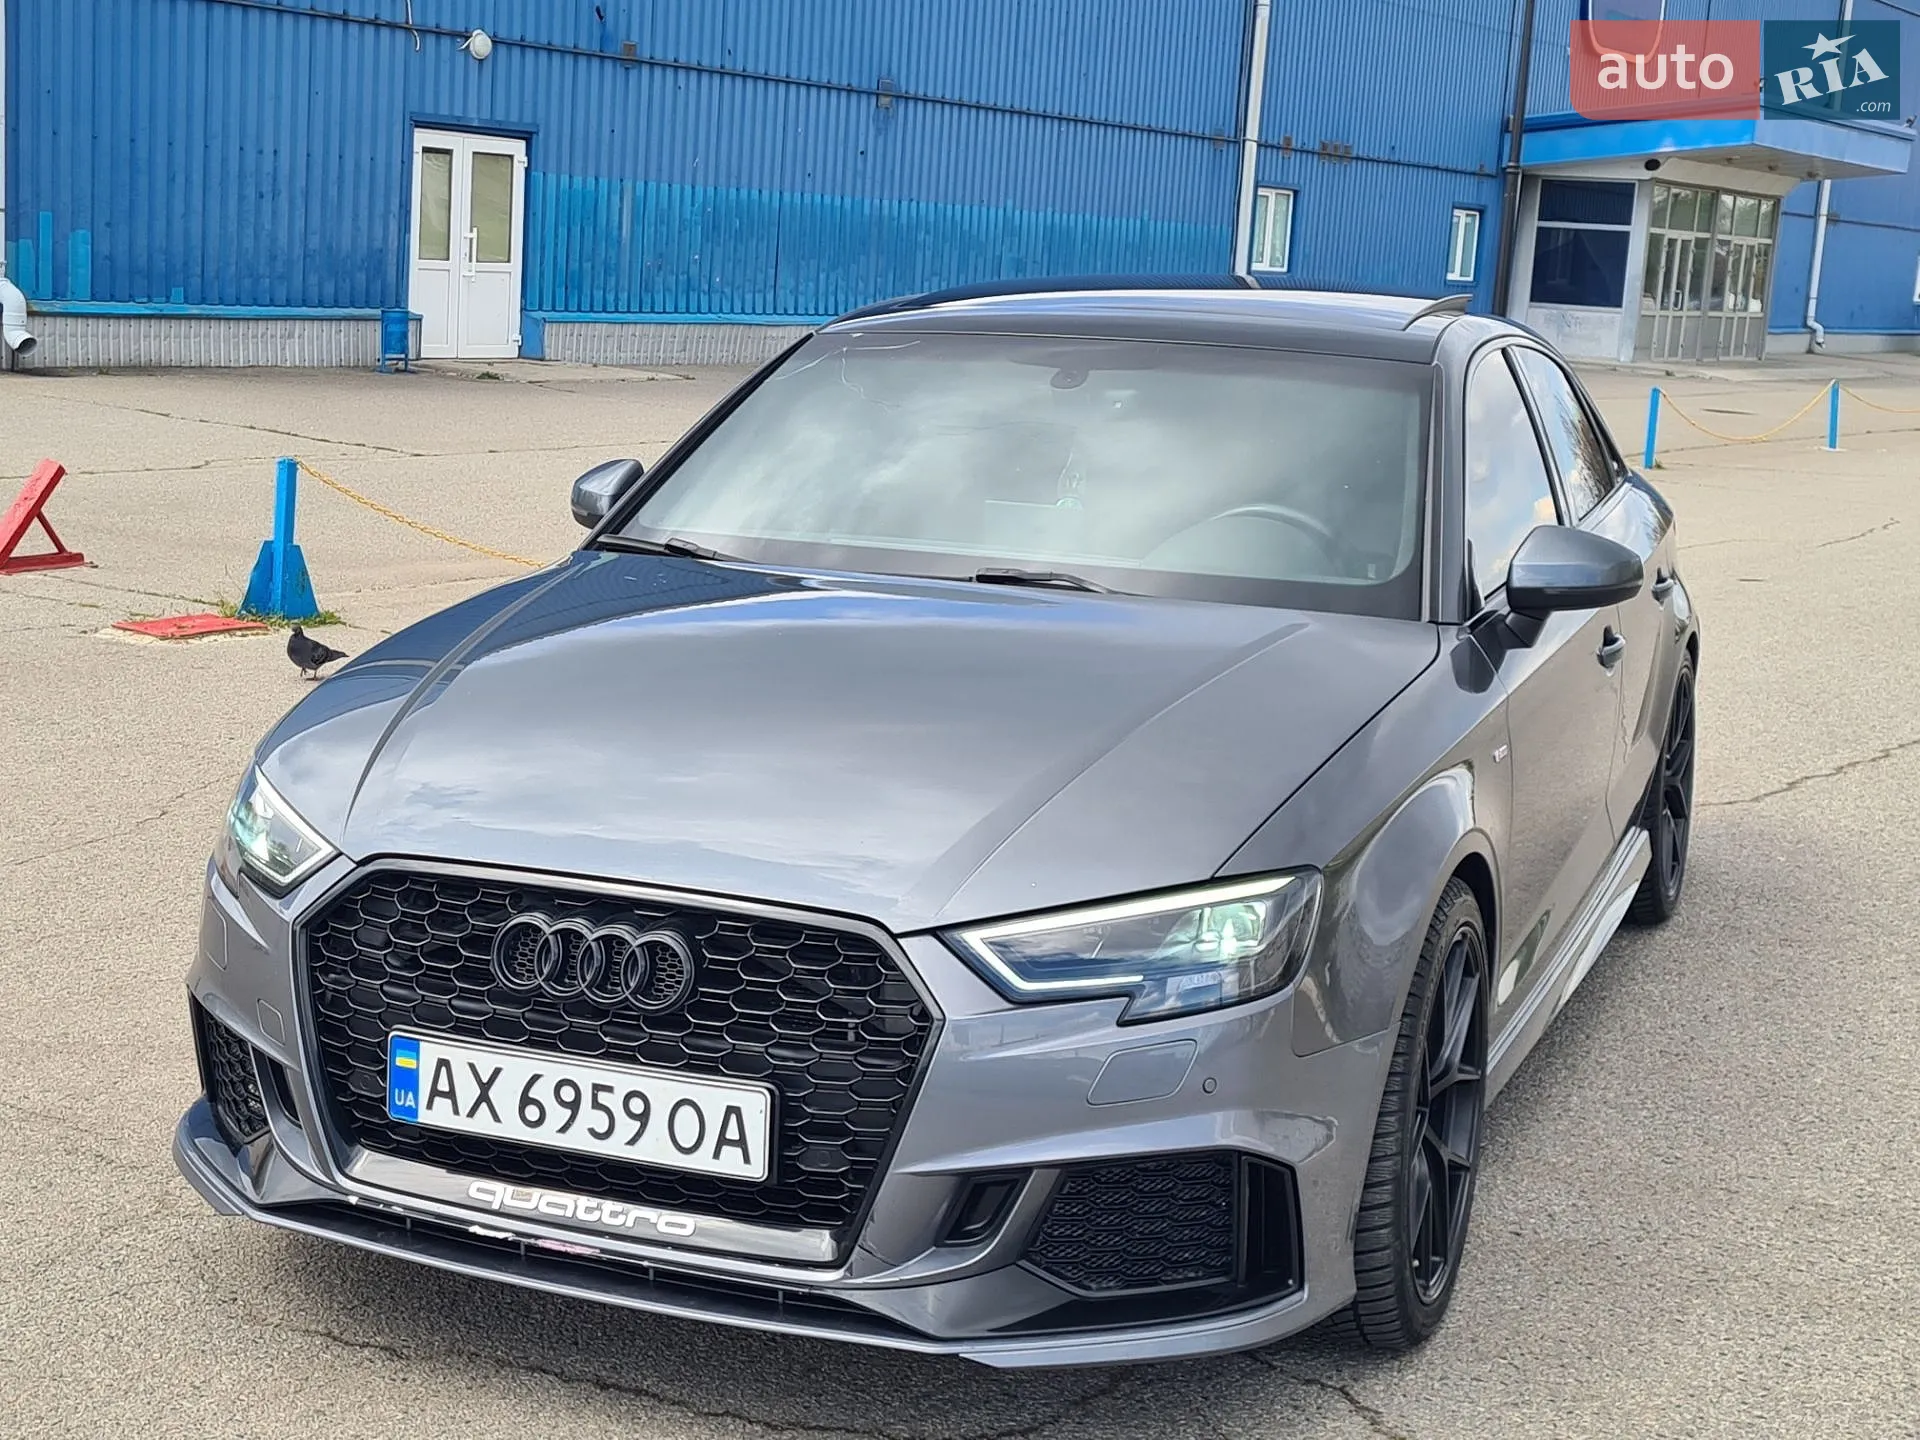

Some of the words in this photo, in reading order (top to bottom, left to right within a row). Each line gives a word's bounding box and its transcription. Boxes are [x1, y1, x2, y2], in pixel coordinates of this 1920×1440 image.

[394, 1089, 416, 1109] UA
[426, 1057, 504, 1124] AX
[518, 1073, 651, 1146] 6959
[668, 1097, 752, 1166] OA
[467, 1180, 697, 1237] quattro
